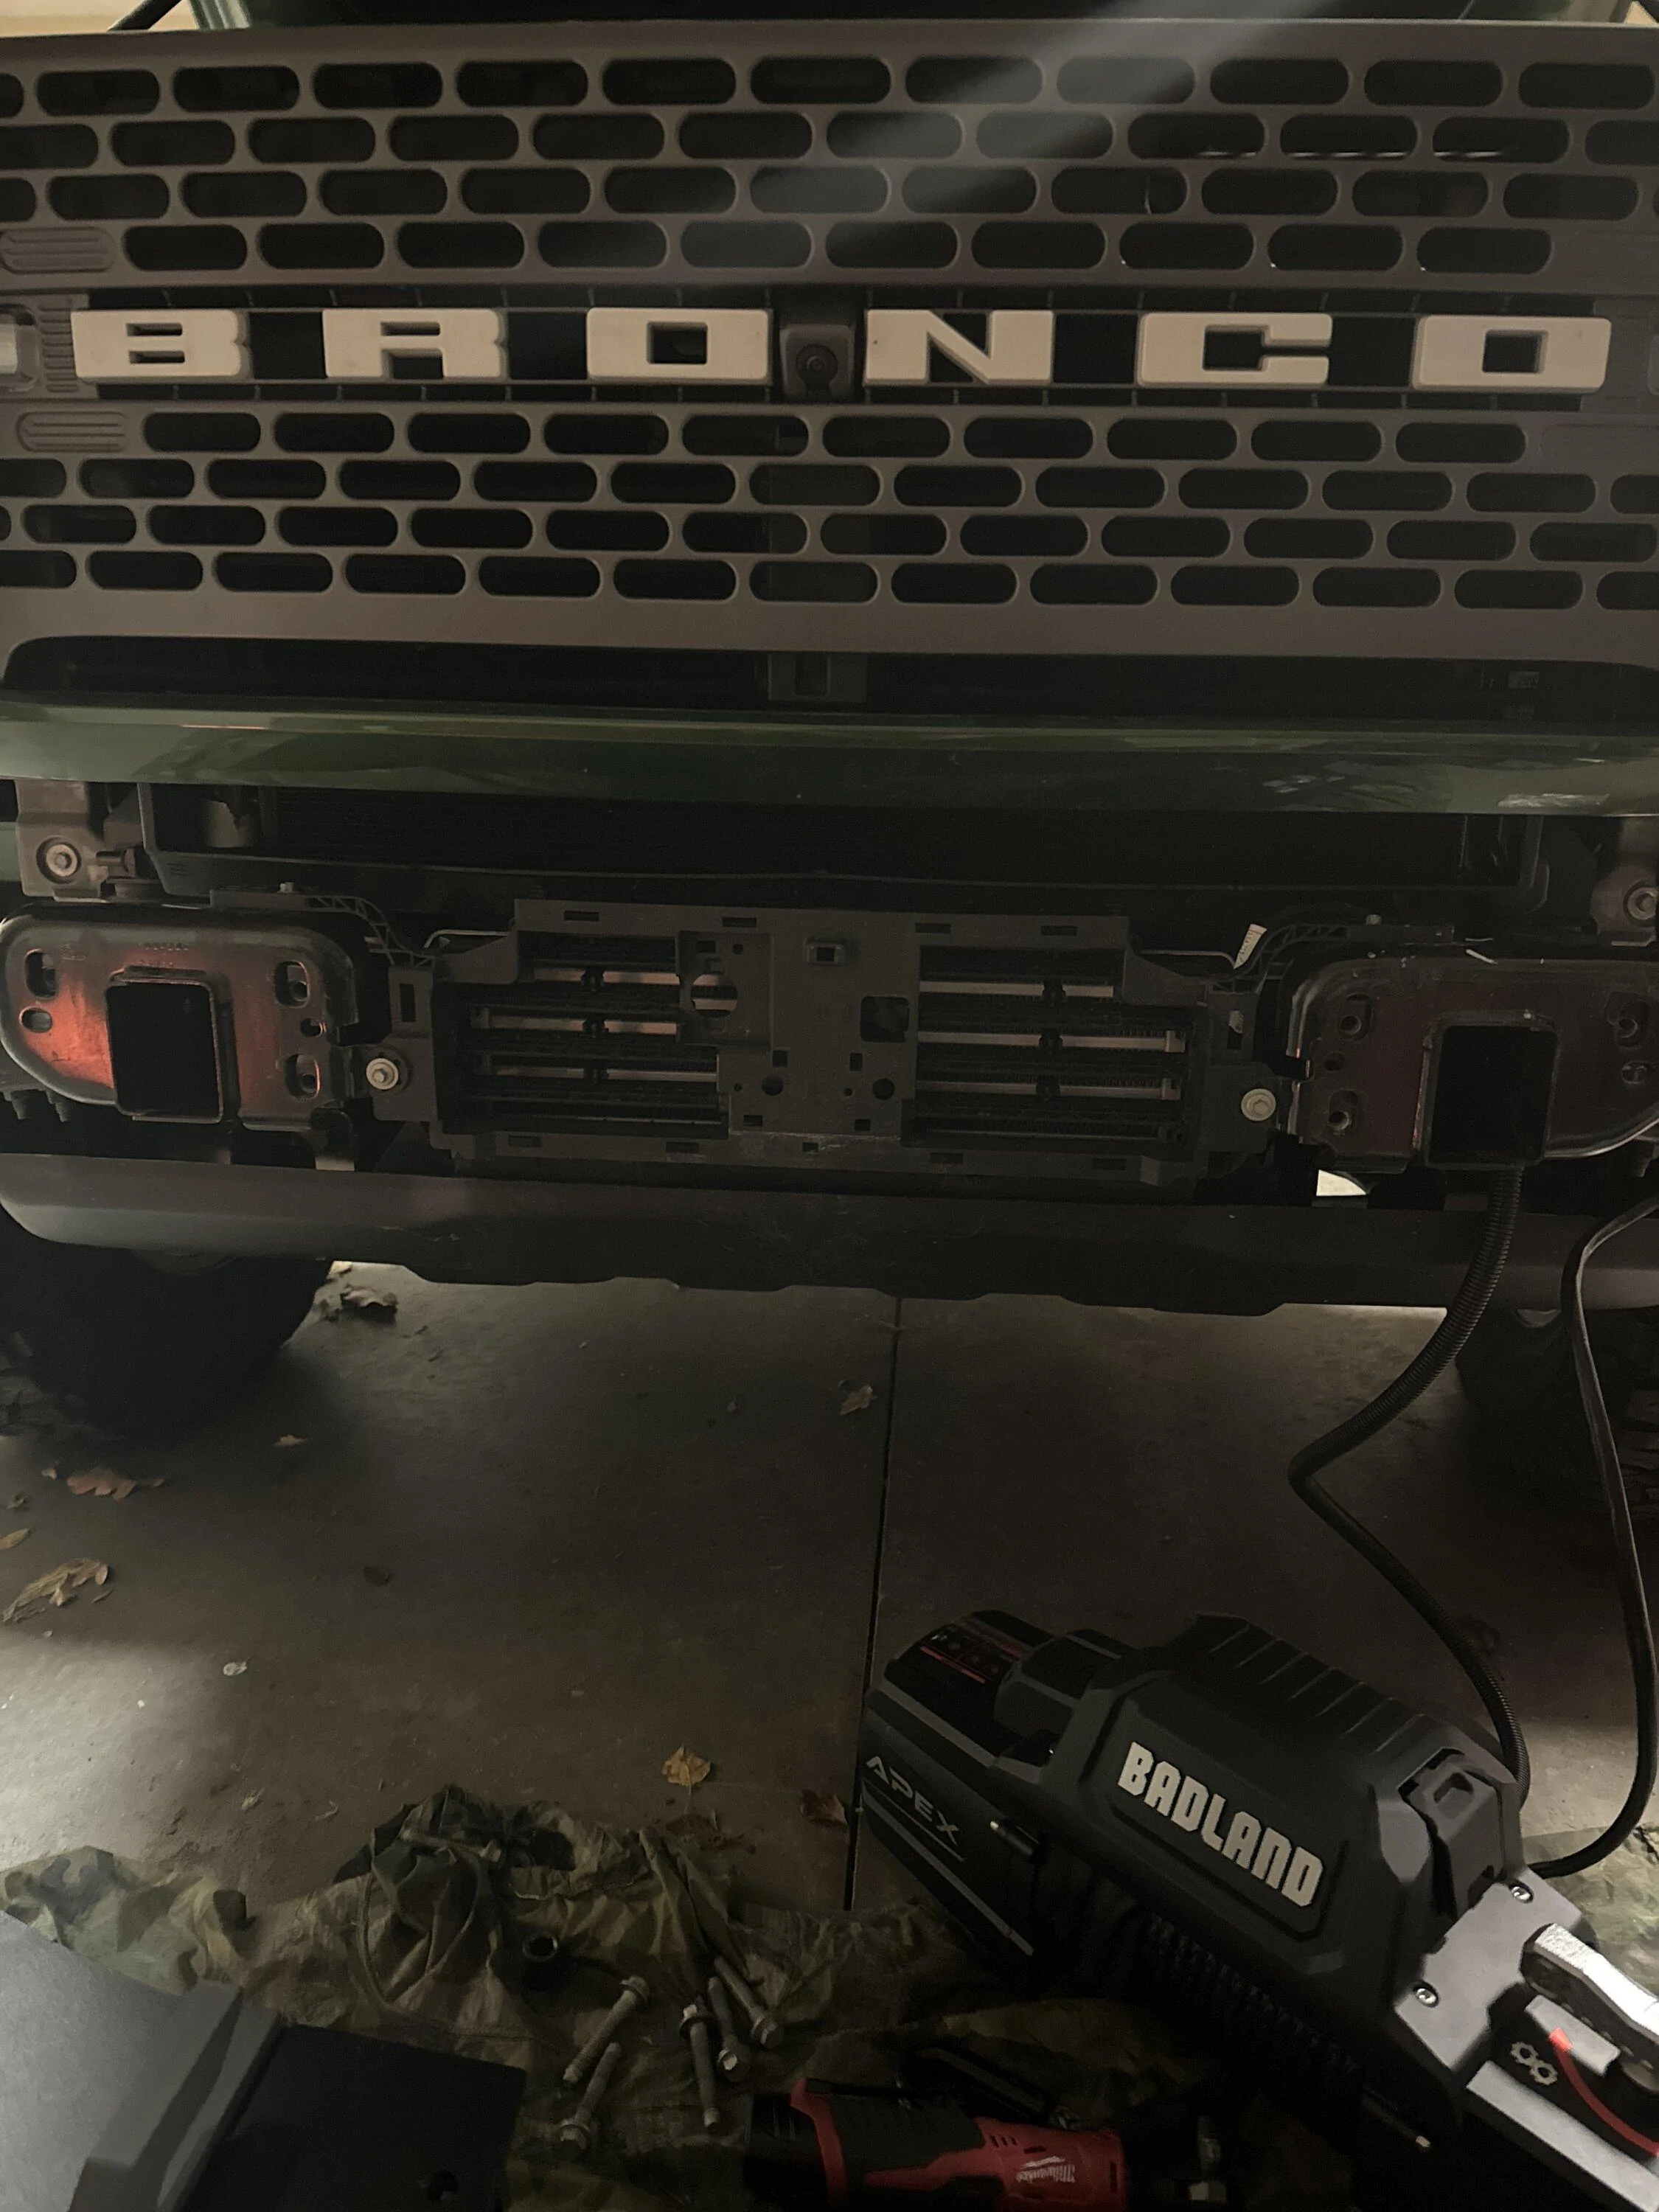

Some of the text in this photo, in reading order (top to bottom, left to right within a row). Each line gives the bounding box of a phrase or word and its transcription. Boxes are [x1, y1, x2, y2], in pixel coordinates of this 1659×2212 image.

[70, 307, 1612, 393] BRONCO
[866, 1756, 960, 1846] APEX
[1117, 1741, 1325, 1908] BADLAND
